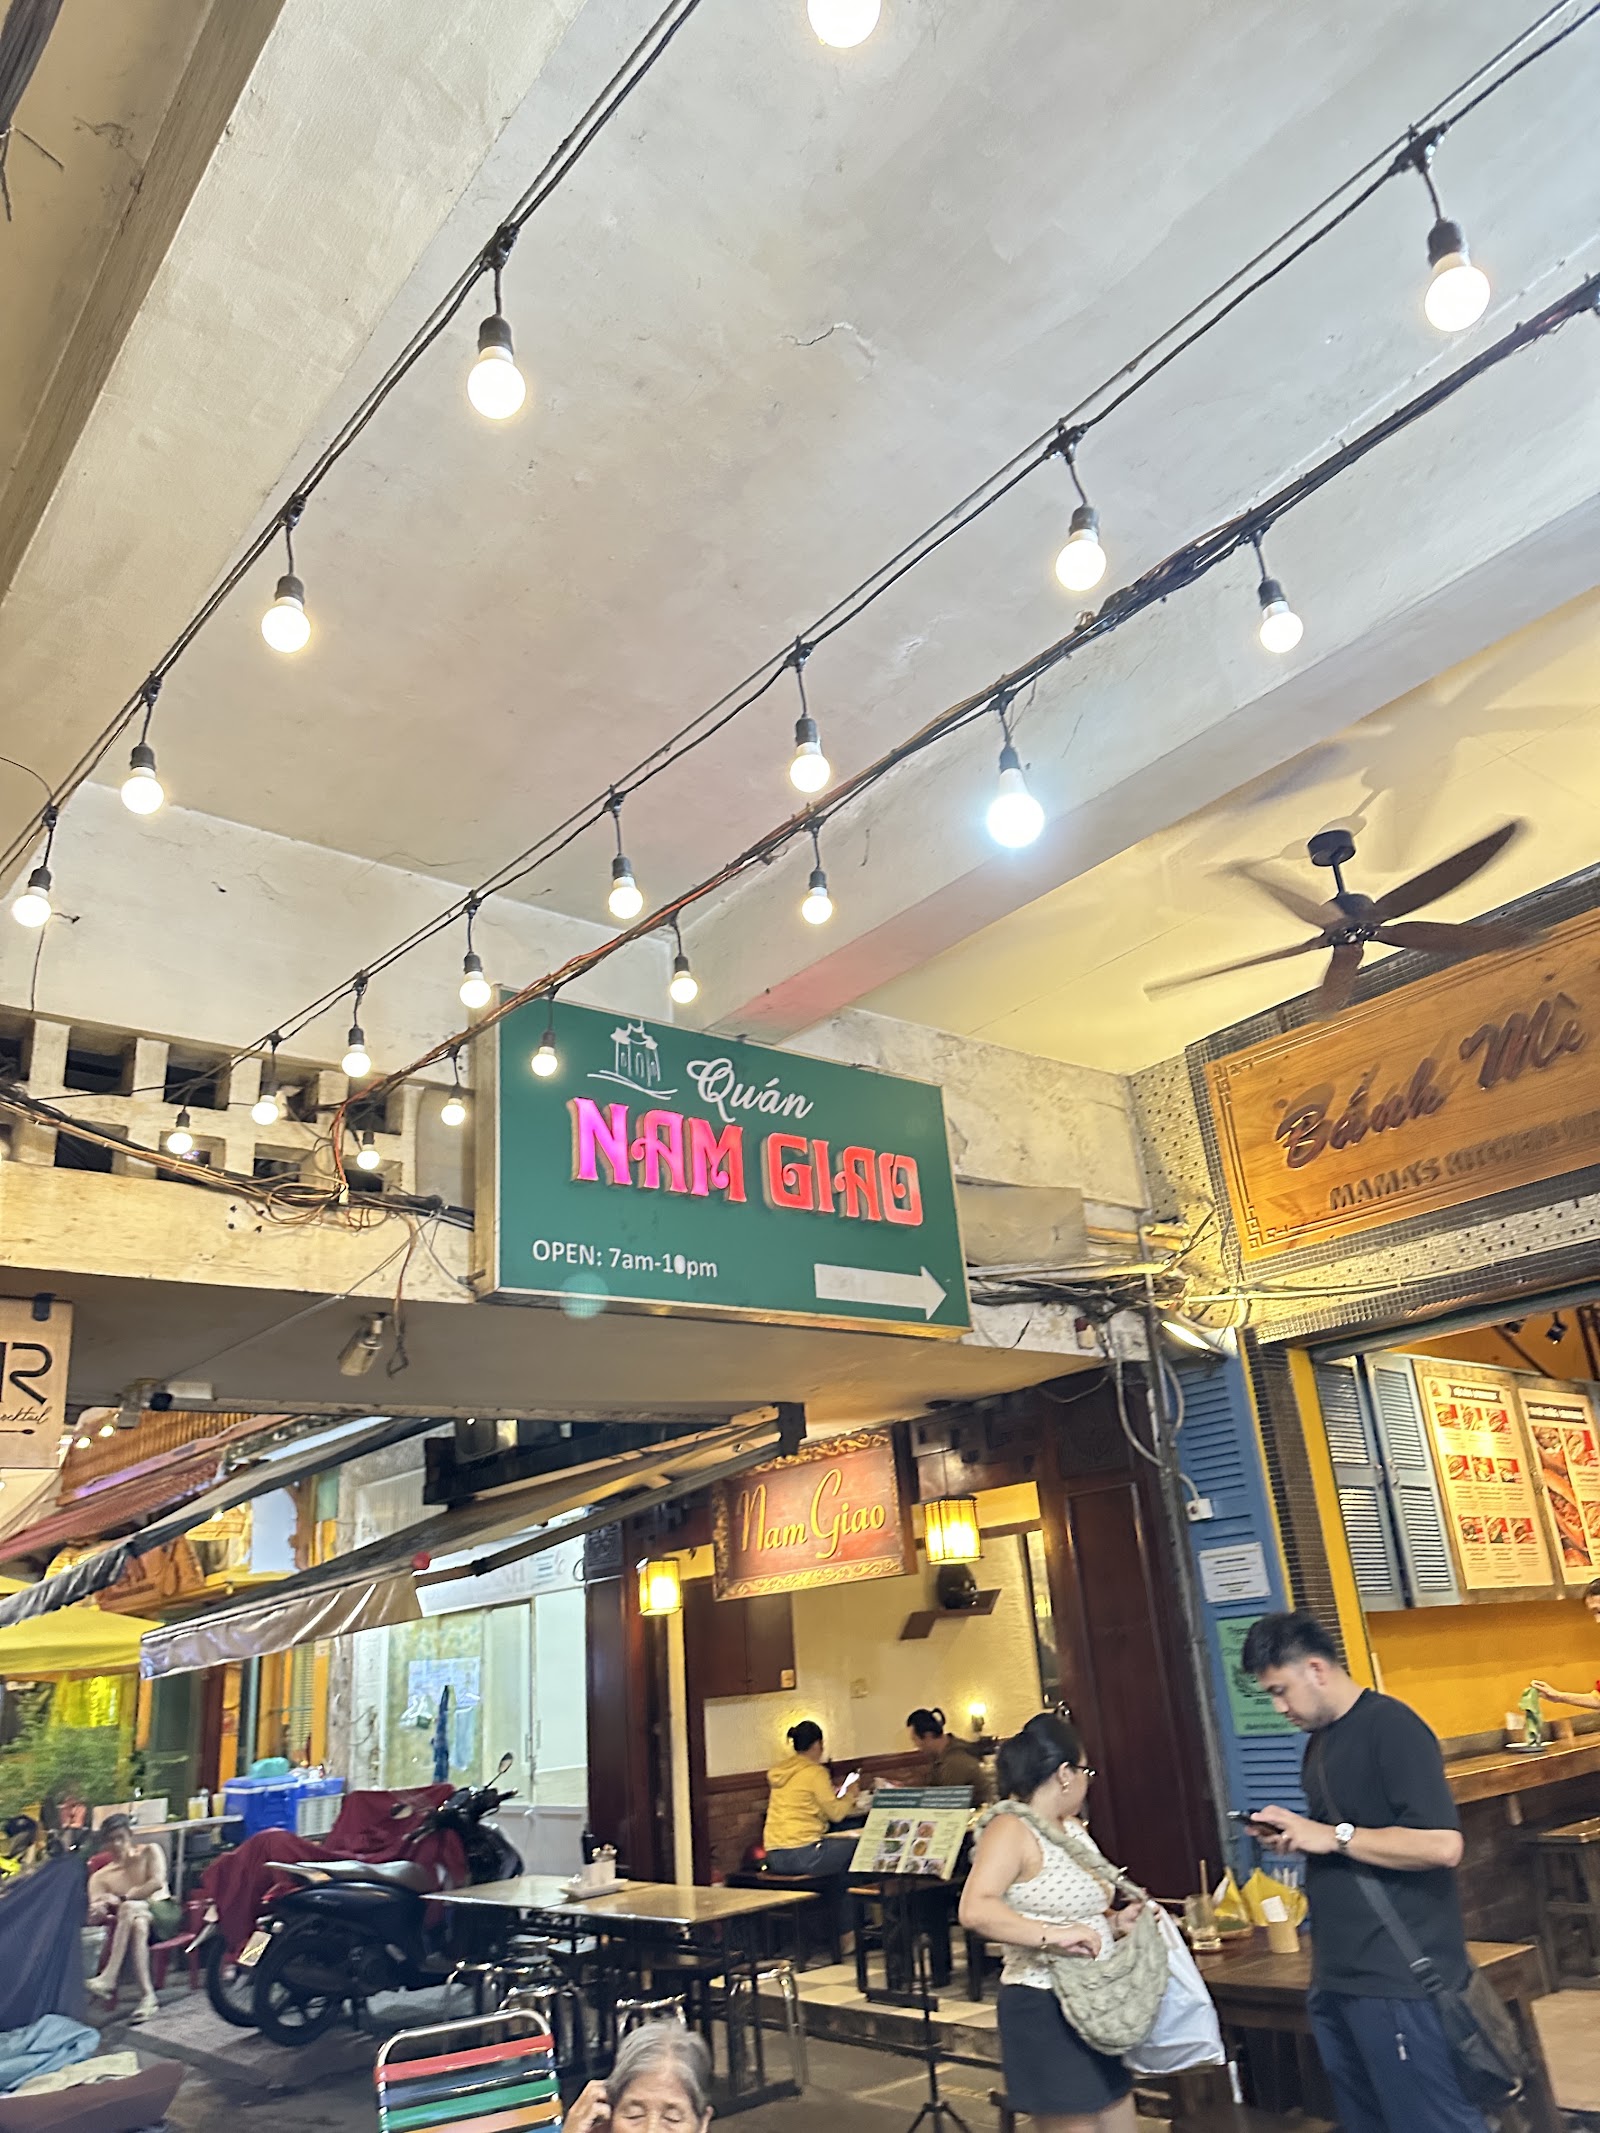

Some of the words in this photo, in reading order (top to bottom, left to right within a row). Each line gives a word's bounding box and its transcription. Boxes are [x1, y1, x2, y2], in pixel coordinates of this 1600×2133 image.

[687, 1057, 814, 1123] Quán
[569, 1097, 748, 1202] NAM
[764, 1132, 925, 1227] GIAO
[532, 1239, 603, 1267] OPEN:
[608, 1247, 718, 1280] 7am-10pm
[0, 1341, 53, 1405] R
[0, 1406, 53, 1424] ocktail
[737, 1483, 808, 1553] Nam
[810, 1468, 886, 1560] Giao
